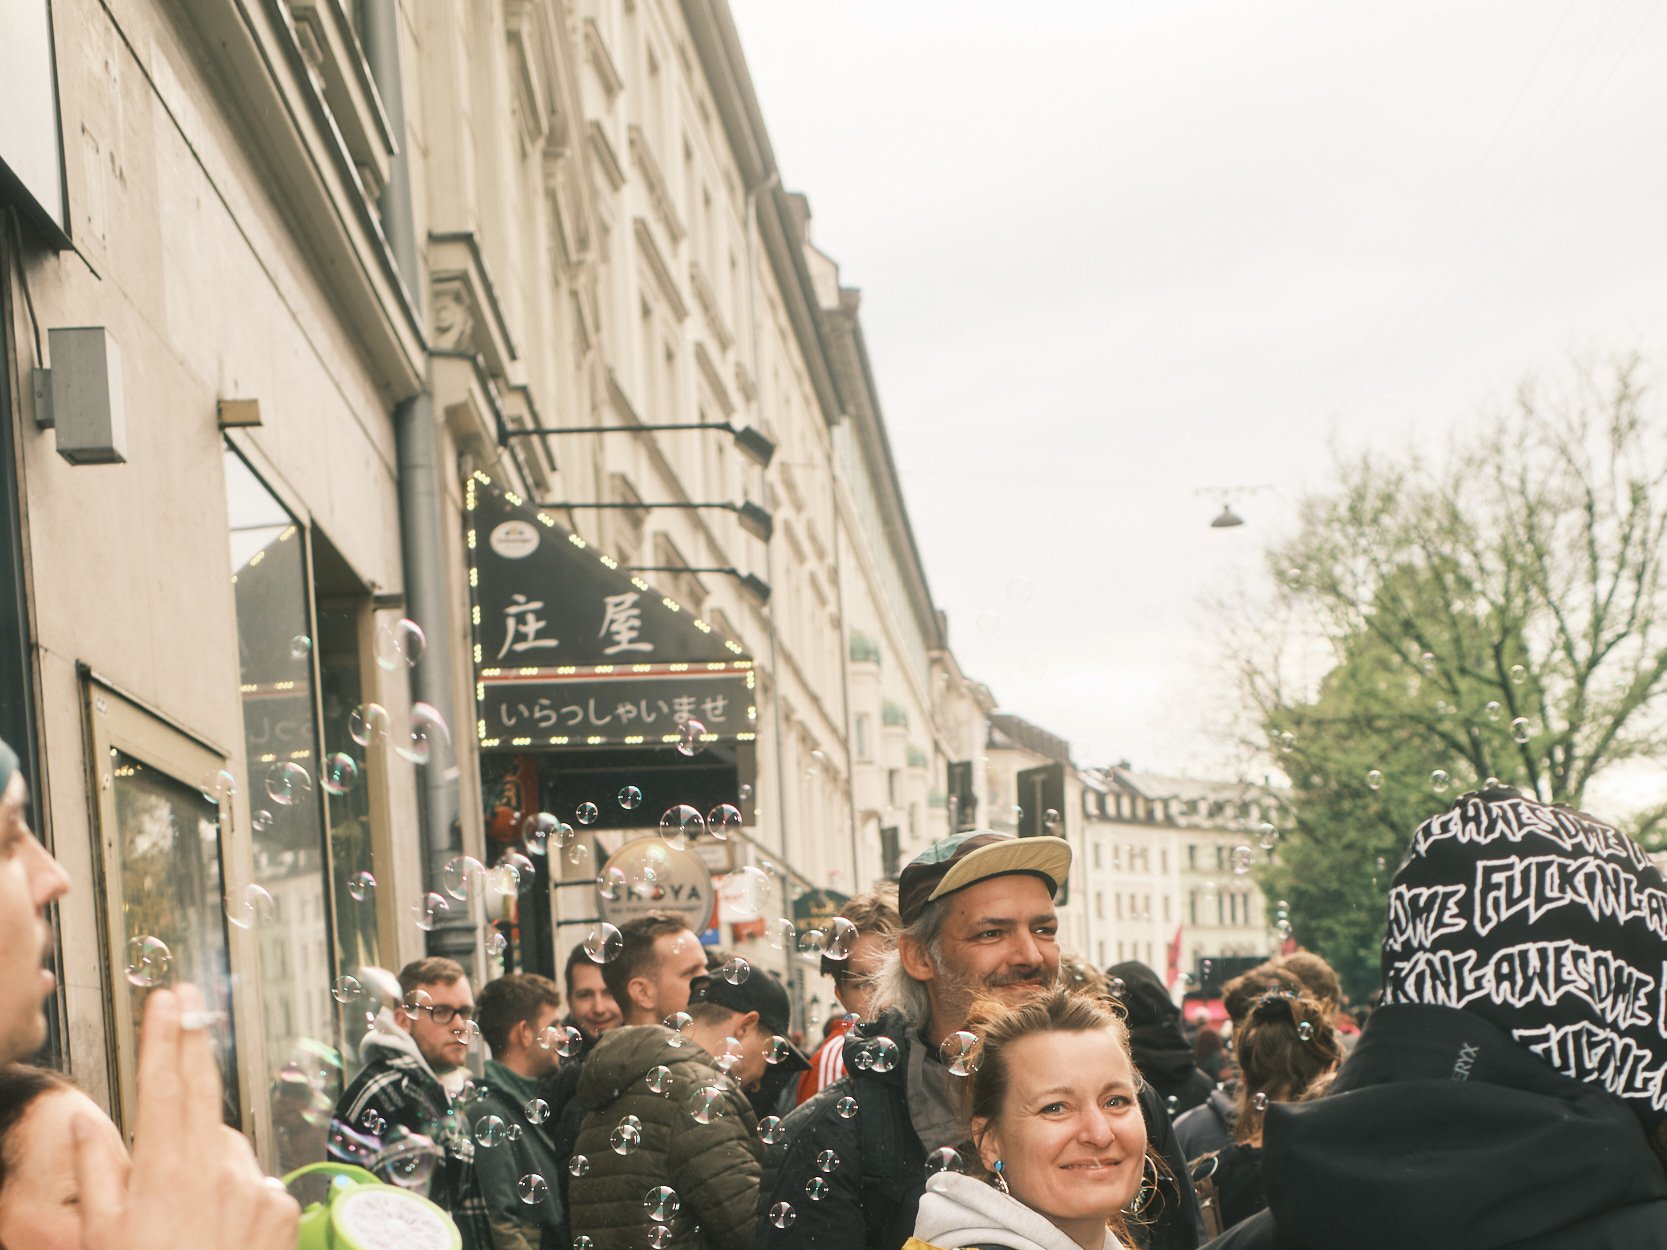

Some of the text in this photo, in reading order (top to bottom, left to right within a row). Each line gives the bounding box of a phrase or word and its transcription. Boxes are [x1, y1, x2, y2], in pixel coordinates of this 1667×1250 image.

[497, 592, 655, 660] 庄屋
[500, 695, 729, 728] いらっしゃいませ
